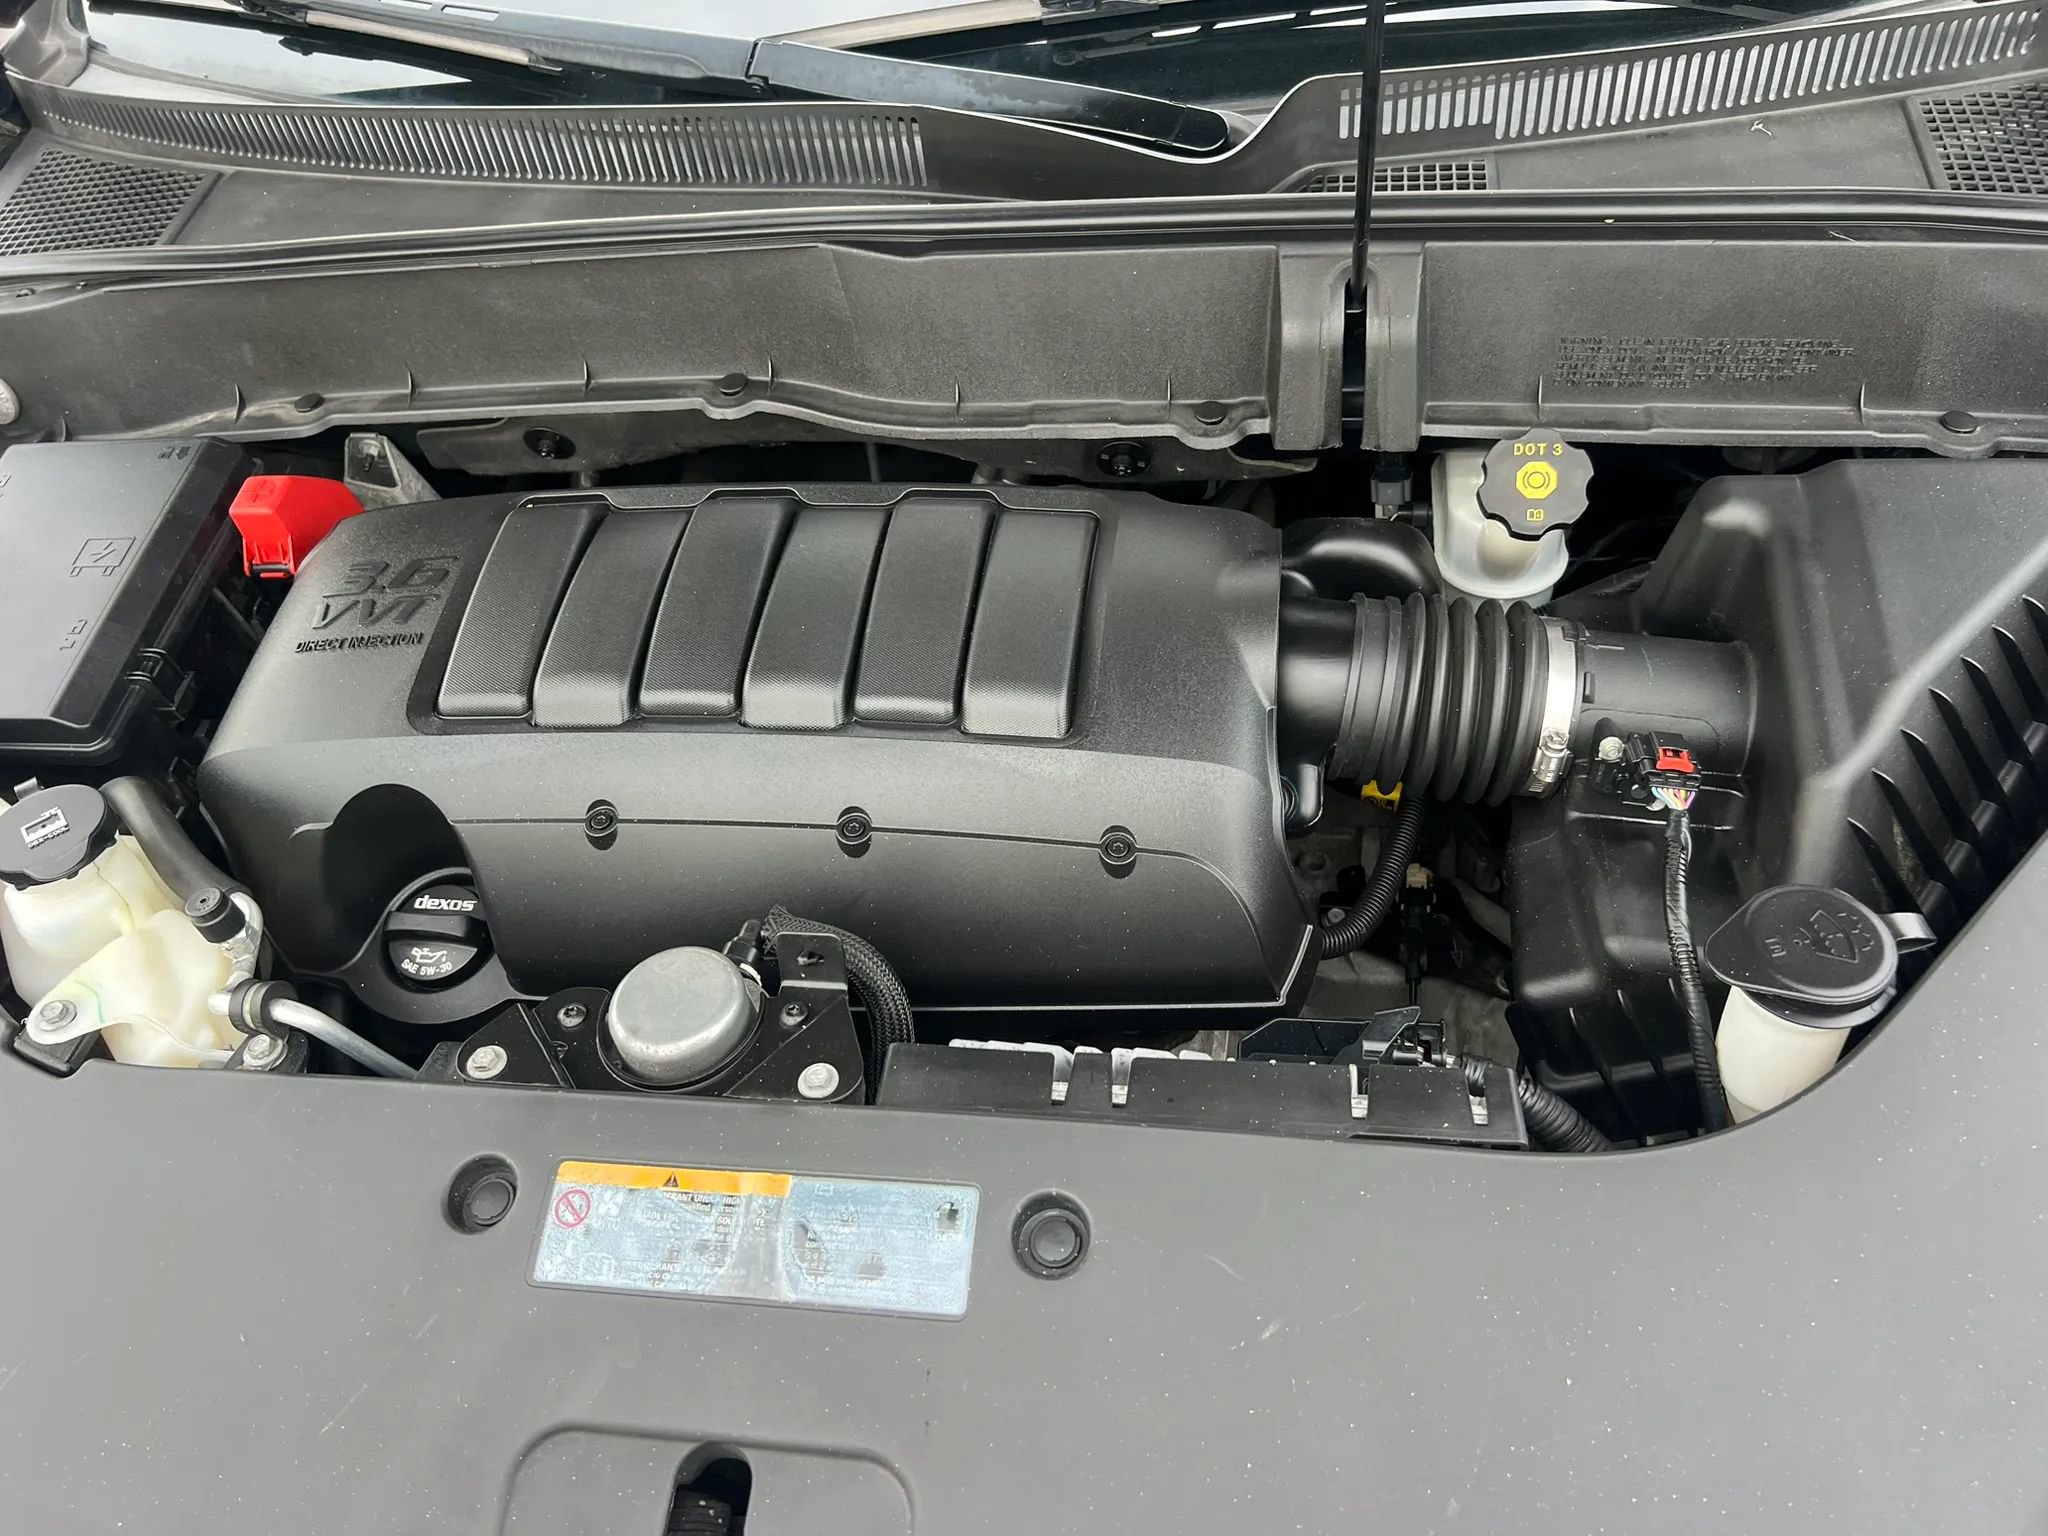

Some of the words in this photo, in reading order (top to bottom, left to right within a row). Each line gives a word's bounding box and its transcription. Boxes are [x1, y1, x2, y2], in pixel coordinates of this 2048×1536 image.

[1513, 442, 1548, 456] DOT
[1552, 443, 1563, 456] 3
[323, 556, 460, 598] 3.6
[312, 594, 441, 630] VVT
[295, 635, 348, 653] DIRECT
[349, 632, 424, 650] INJECTION
[414, 895, 478, 911] dexos
[401, 958, 420, 974] SAE
[420, 961, 453, 976] 5W-30
